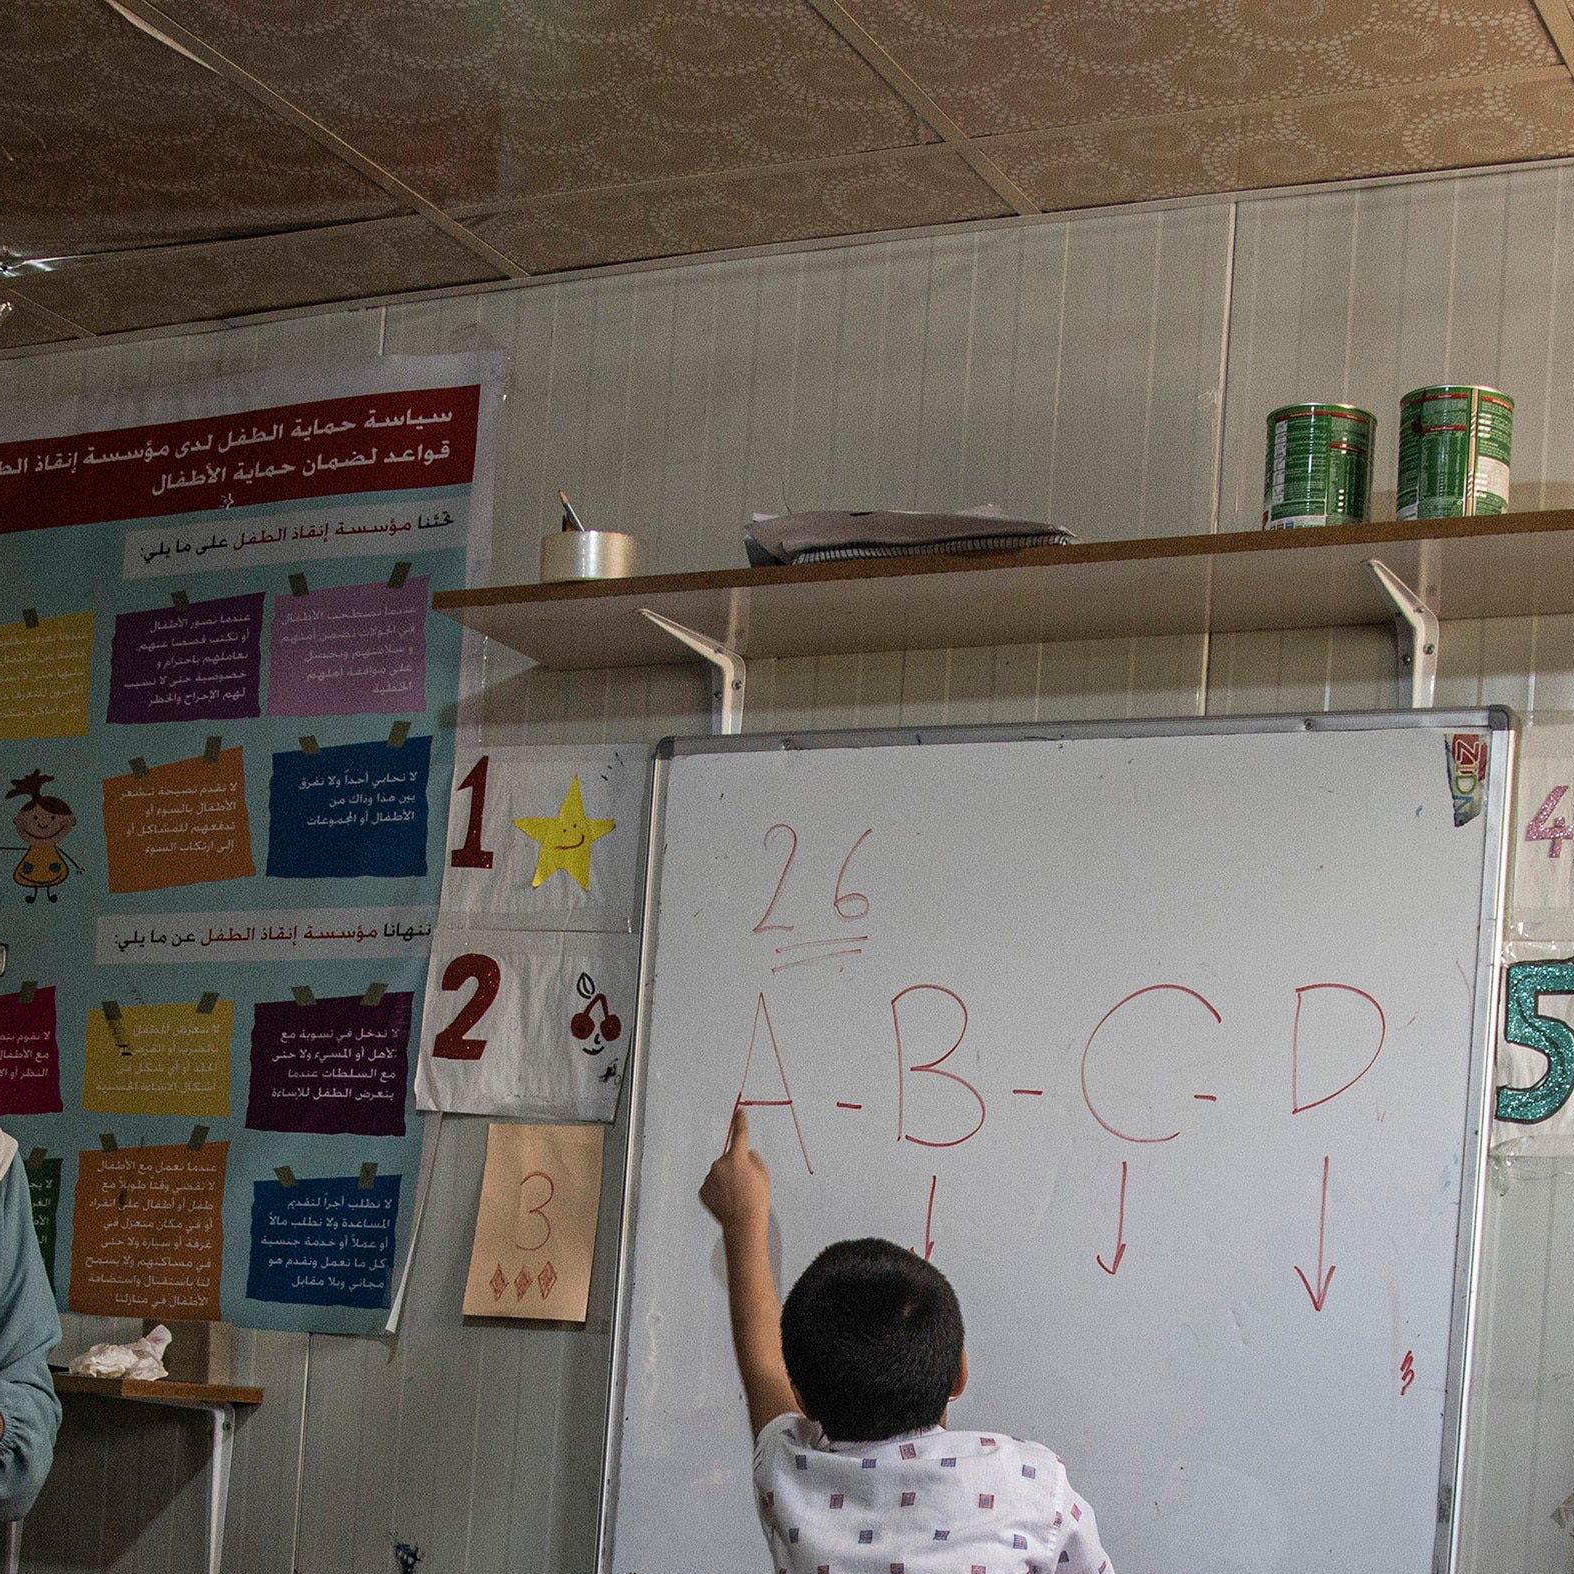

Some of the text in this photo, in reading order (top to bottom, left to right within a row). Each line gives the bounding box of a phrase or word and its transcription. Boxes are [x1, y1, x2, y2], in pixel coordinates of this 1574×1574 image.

[291, 419, 355, 440] حماية
[363, 408, 453, 429] سياسة
[175, 434, 213, 459] لدى
[218, 424, 283, 453] الطفل
[35, 452, 78, 475] إنقاذ
[83, 442, 169, 465] مؤسسة
[152, 442, 450, 496] قواعد لضمان حماية الأطفال
[292, 523, 329, 542] إنقاذ
[335, 518, 411, 536] مؤسسة
[176, 540, 191, 553] ما
[195, 537, 228, 556] على
[233, 527, 287, 551] الطفل
[450, 755, 494, 869] 1
[1525, 784, 1574, 859] 4
[751, 823, 874, 933] 26
[151, 930, 167, 944] ما
[171, 932, 195, 946] عن
[201, 928, 255, 946] الطفل
[261, 926, 297, 946] إنقاذ
[304, 926, 377, 942] مؤسسة
[432, 952, 502, 1060] 2
[513, 1171, 554, 1251] 3
